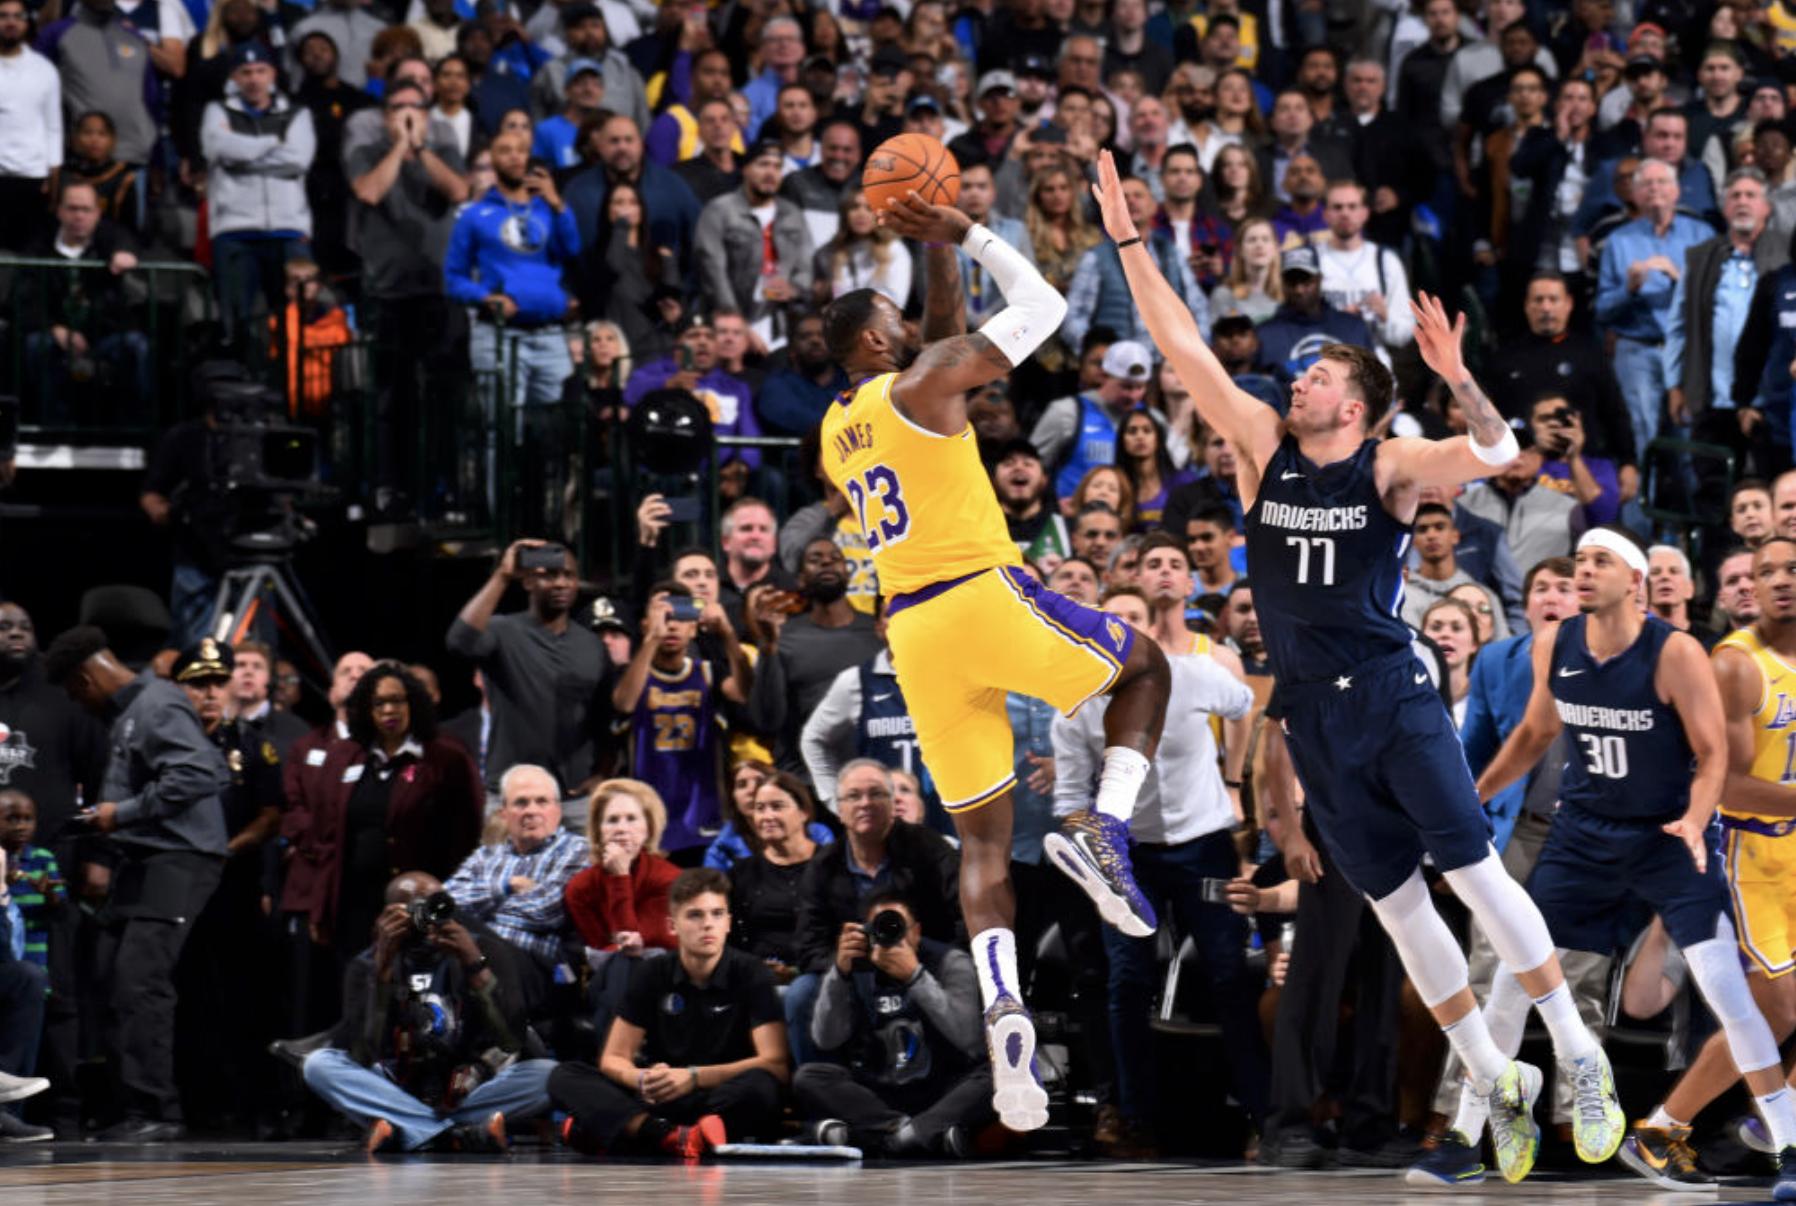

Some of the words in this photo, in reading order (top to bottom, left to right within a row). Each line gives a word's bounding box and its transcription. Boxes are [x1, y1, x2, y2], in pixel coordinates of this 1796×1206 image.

[833, 422, 873, 463] JAMES
[845, 464, 911, 556] 23
[1261, 500, 1368, 531] MAVERICKS
[1286, 536, 1335, 585] 77
[654, 713, 695, 752] 23
[1579, 733, 1628, 779] 30
[879, 995, 901, 1013] 30
